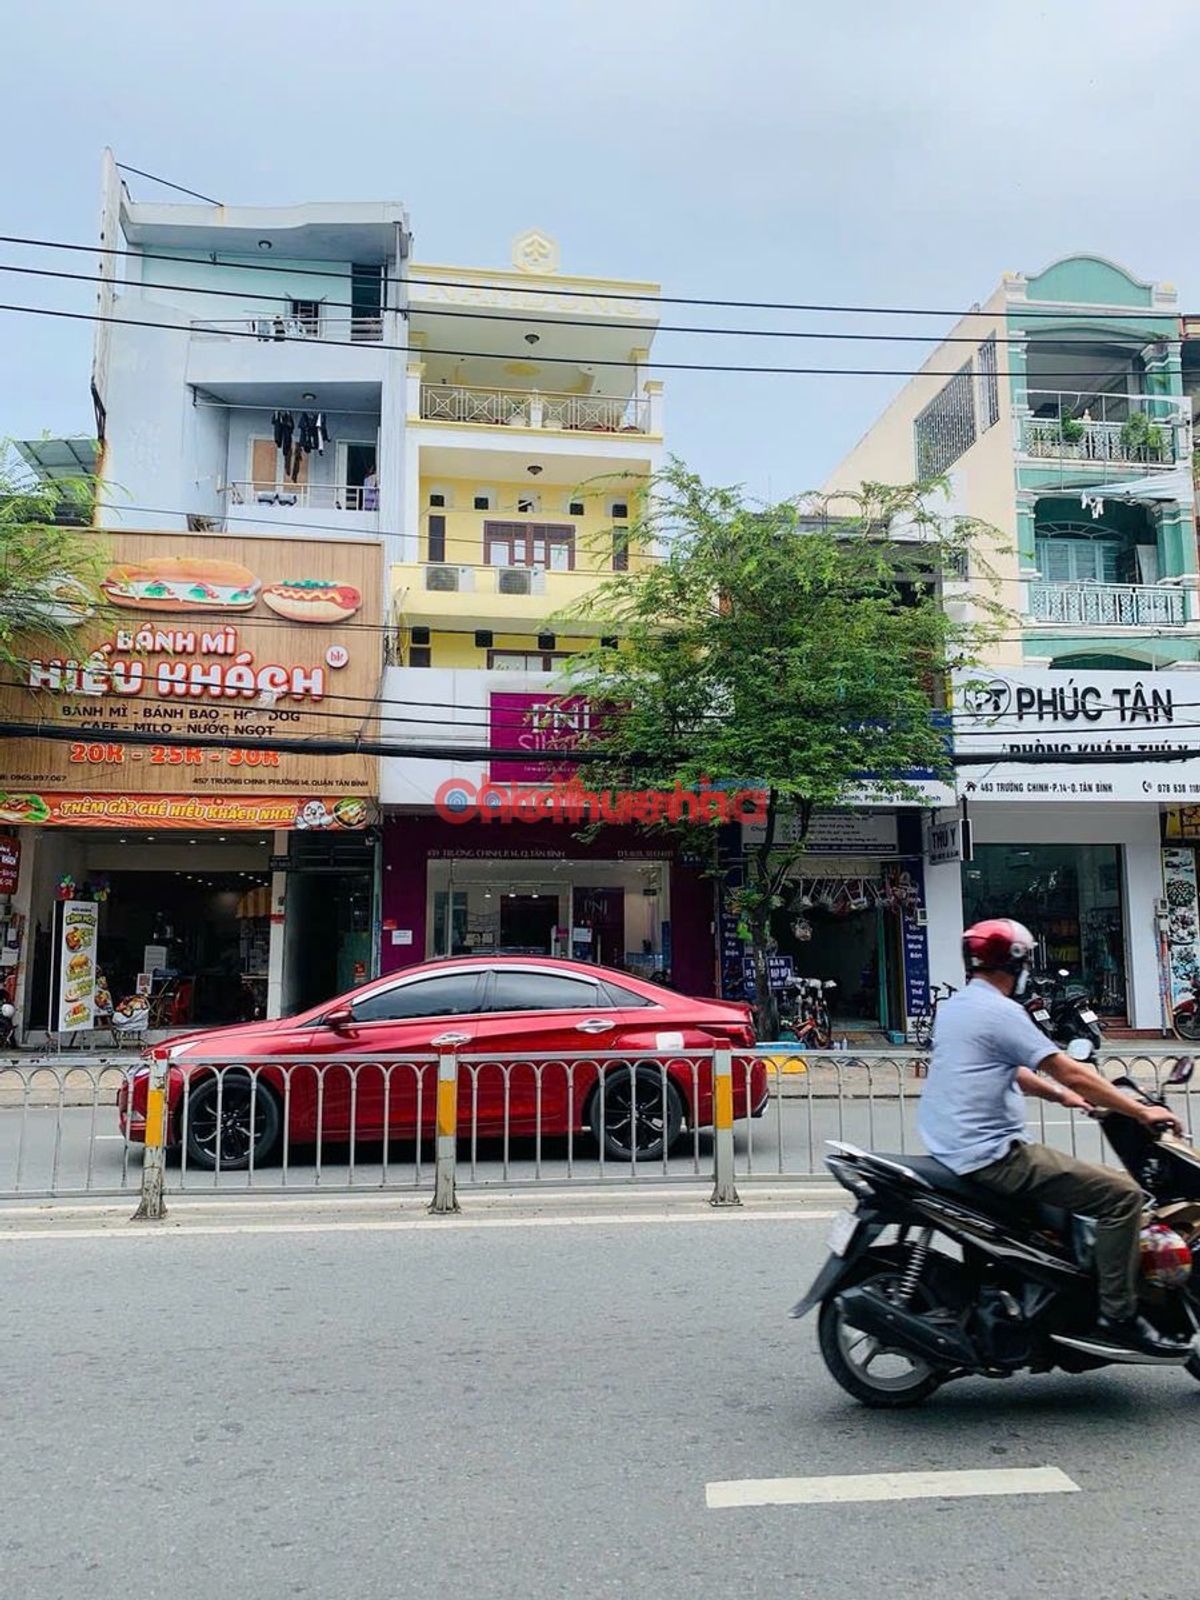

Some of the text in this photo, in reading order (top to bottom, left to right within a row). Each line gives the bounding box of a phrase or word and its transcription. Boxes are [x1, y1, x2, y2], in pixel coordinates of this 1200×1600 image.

[116, 622, 236, 656] BÁNH MÌ
[157, 651, 326, 703] KHÁCH
[62, 704, 103, 718] BÁNH
[109, 704, 128, 718] MÌ
[143, 705, 184, 720] BÁNH
[189, 708, 220, 721] BAO
[1016, 678, 1174, 723] PHÚC TÂN
[133, 721, 172, 734] MILO
[234, 723, 275, 738] NGỌT
[70, 743, 124, 765] 20K
[149, 745, 205, 767] 25K
[62, 798, 104, 816] THÈM
[108, 798, 136, 816] GÀ?
[206, 803, 257, 822] KHÁCH
